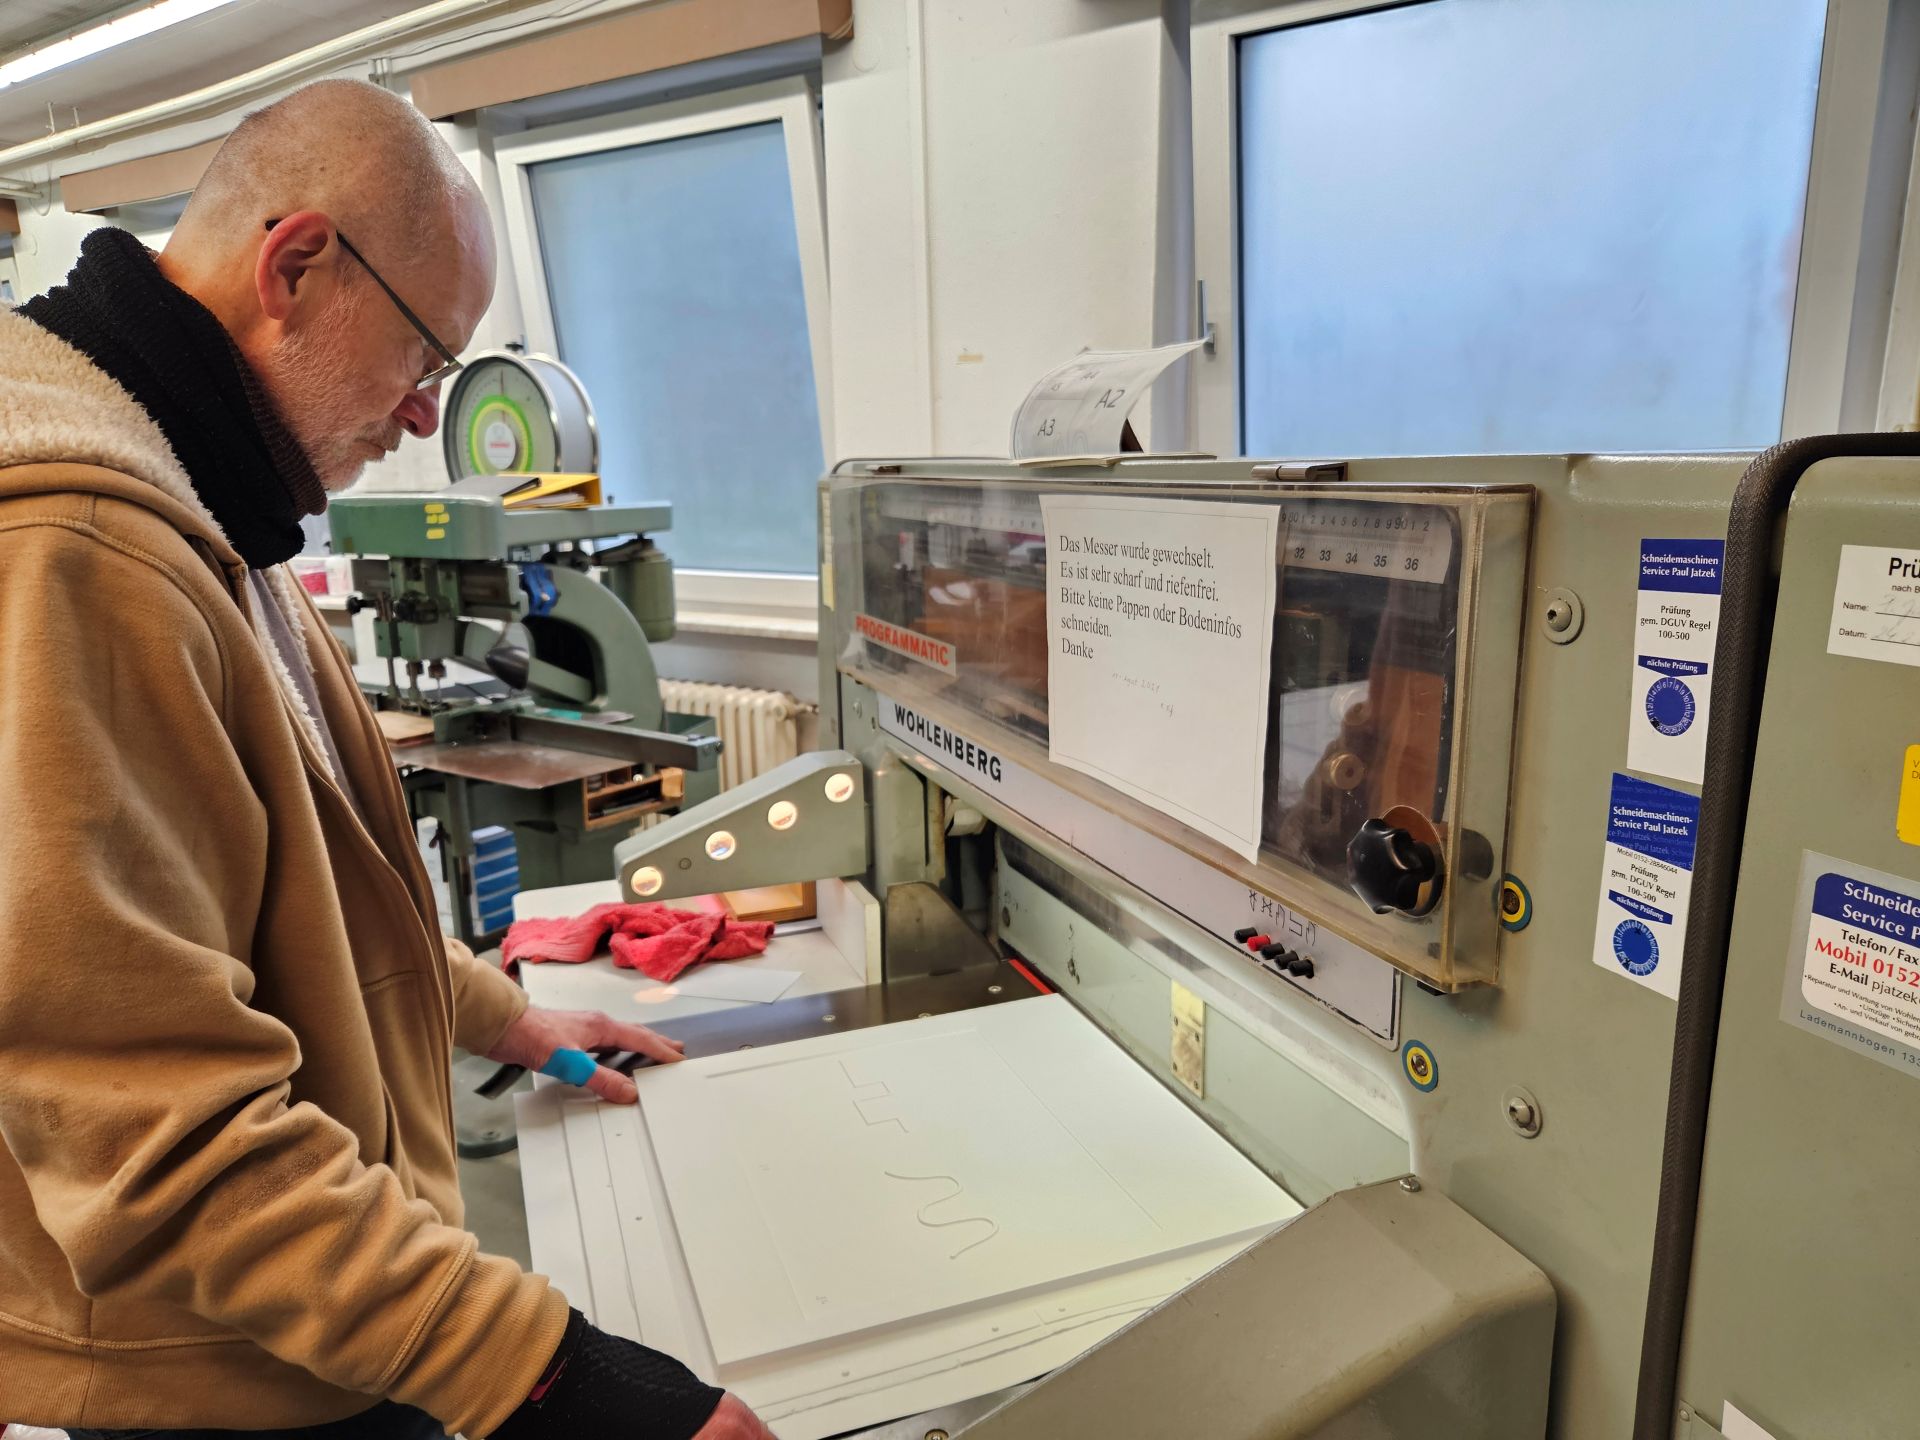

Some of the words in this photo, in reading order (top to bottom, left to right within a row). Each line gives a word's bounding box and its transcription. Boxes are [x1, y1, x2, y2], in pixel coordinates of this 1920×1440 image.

[1095, 389, 1125, 408] A2
[1037, 419, 1055, 436] A3
[1060, 535, 1080, 552] Das
[1083, 537, 1118, 557] Messer
[1121, 542, 1150, 561] wurde
[1152, 546, 1214, 569] gewechselt.
[1294, 547, 1305, 559] 32
[1320, 550, 1331, 561] 33
[1346, 553, 1358, 564] 34
[1374, 555, 1387, 567] 35
[1405, 558, 1419, 571] 36
[1641, 554, 1719, 565] Schneidemaschinen
[1642, 566, 1670, 576] Service
[1672, 567, 1689, 577] Paul
[1691, 568, 1716, 578] Jatzek
[1888, 557, 1920, 578] Prü
[1060, 561, 1073, 579] Es
[1077, 562, 1088, 580] ist
[1091, 565, 1111, 583] sehr
[1113, 568, 1143, 588] scharf
[1144, 574, 1163, 592] und
[1166, 577, 1219, 601] riefenfrei.
[1892, 584, 1911, 593] nach
[1061, 587, 1085, 606] Bitte
[1088, 590, 1114, 611] keine
[1116, 595, 1150, 620] Pappen
[1153, 604, 1176, 624] oder
[1179, 607, 1242, 639] Bodeninfos
[1660, 605, 1691, 617] Prüfung
[1843, 601, 1869, 611] Name:
[1061, 614, 1112, 637] schneiden.
[1640, 617, 1658, 626] gem.
[1660, 618, 1687, 629] DGUV
[1689, 620, 1711, 630] Regel
[1839, 628, 1867, 638] Datum:
[856, 615, 949, 666] PROGRAMMATIC
[1658, 630, 1690, 641] 100-500
[1062, 638, 1094, 659] Danke
[1647, 659, 1671, 668] nächste
[1672, 662, 1698, 674] Prüfung
[895, 703, 1001, 783] WOHLENBERG
[1613, 806, 1692, 824] Schneidemaschinen-
[1614, 818, 1641, 829] Service
[1644, 821, 1661, 832] Paul
[1663, 824, 1688, 836] Jatzek
[1617, 848, 1633, 857] Mobil
[1631, 864, 1658, 882] Prüfung
[1611, 870, 1627, 880] gem.
[1630, 875, 1654, 889] DGUV
[1656, 885, 1675, 899] Regel
[1628, 886, 1656, 903] 100-500
[1617, 897, 1639, 909] nächste
[1640, 905, 1664, 921] Prüfung
[1844, 882, 1920, 917] Schneide
[1842, 904, 1905, 935] Service
[1842, 929, 1887, 954] Telefon
[1897, 949, 1919, 966] Fax
[1815, 938, 1867, 968] Mobil
[1873, 958, 1920, 987] 0152
[1808, 975, 1836, 990] Reparatur
[1838, 987, 1850, 996] und
[1852, 991, 1879, 1008] Wartung
[1881, 1004, 1893, 1012] von
[1830, 963, 1868, 986] E-Mail
[1872, 979, 1920, 1005] pjatzek
[1850, 1008, 1862, 1017] und
[1864, 1014, 1889, 1027] Verkauf
[1891, 1025, 1903, 1033] von
[1863, 1005, 1890, 1019] Umzüge
[1800, 1010, 1895, 1056] Lademannbogen
